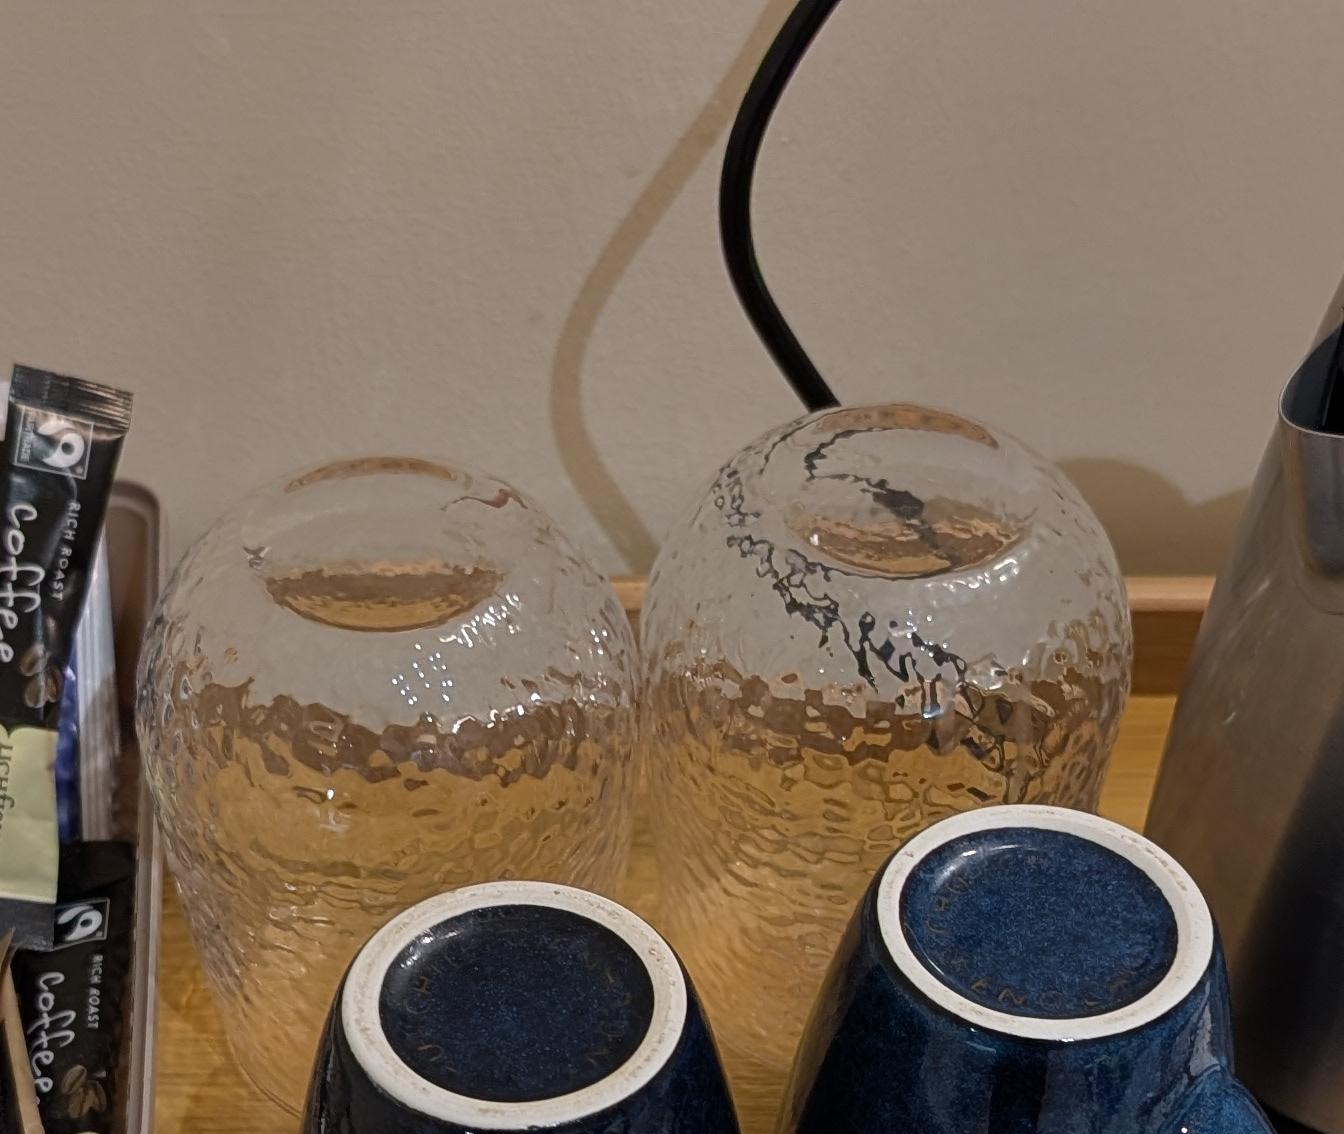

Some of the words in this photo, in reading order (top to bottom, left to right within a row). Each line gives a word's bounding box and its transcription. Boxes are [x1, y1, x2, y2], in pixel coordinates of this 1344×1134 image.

[65, 502, 81, 541] RICH
[52, 547, 72, 601] ROAST
[89, 954, 104, 985] RICH
[87, 988, 104, 1029] ROAST
[27, 971, 76, 1105] coffee
